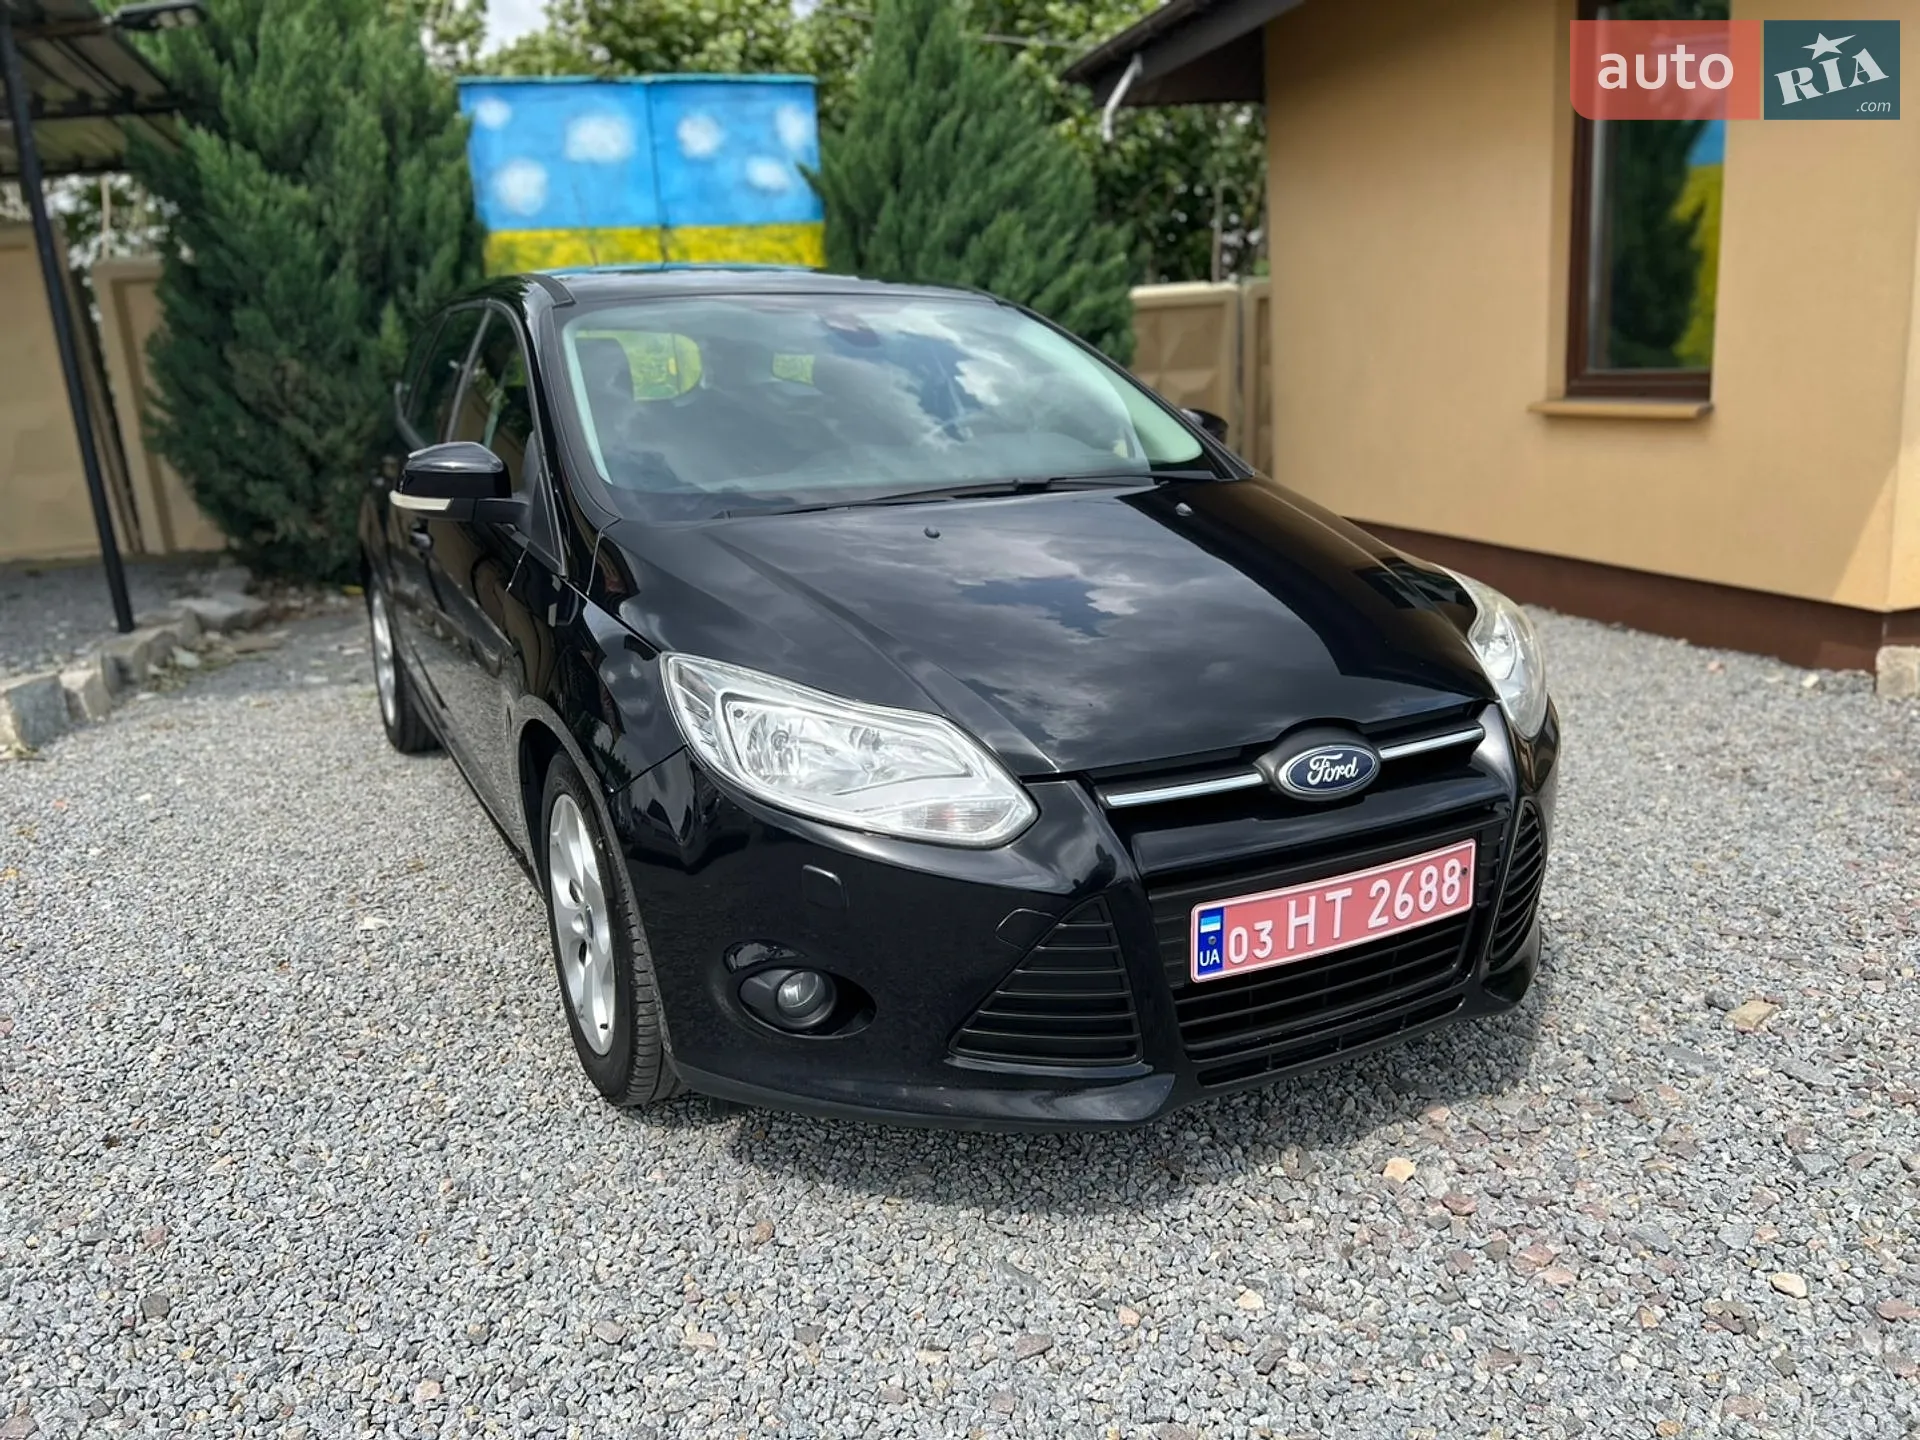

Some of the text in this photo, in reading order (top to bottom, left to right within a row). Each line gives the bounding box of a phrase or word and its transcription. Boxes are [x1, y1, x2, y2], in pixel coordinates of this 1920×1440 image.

[1307, 753, 1358, 785] Ford
[1228, 858, 1461, 964] 03 HT 2688
[1200, 949, 1220, 967] UA
